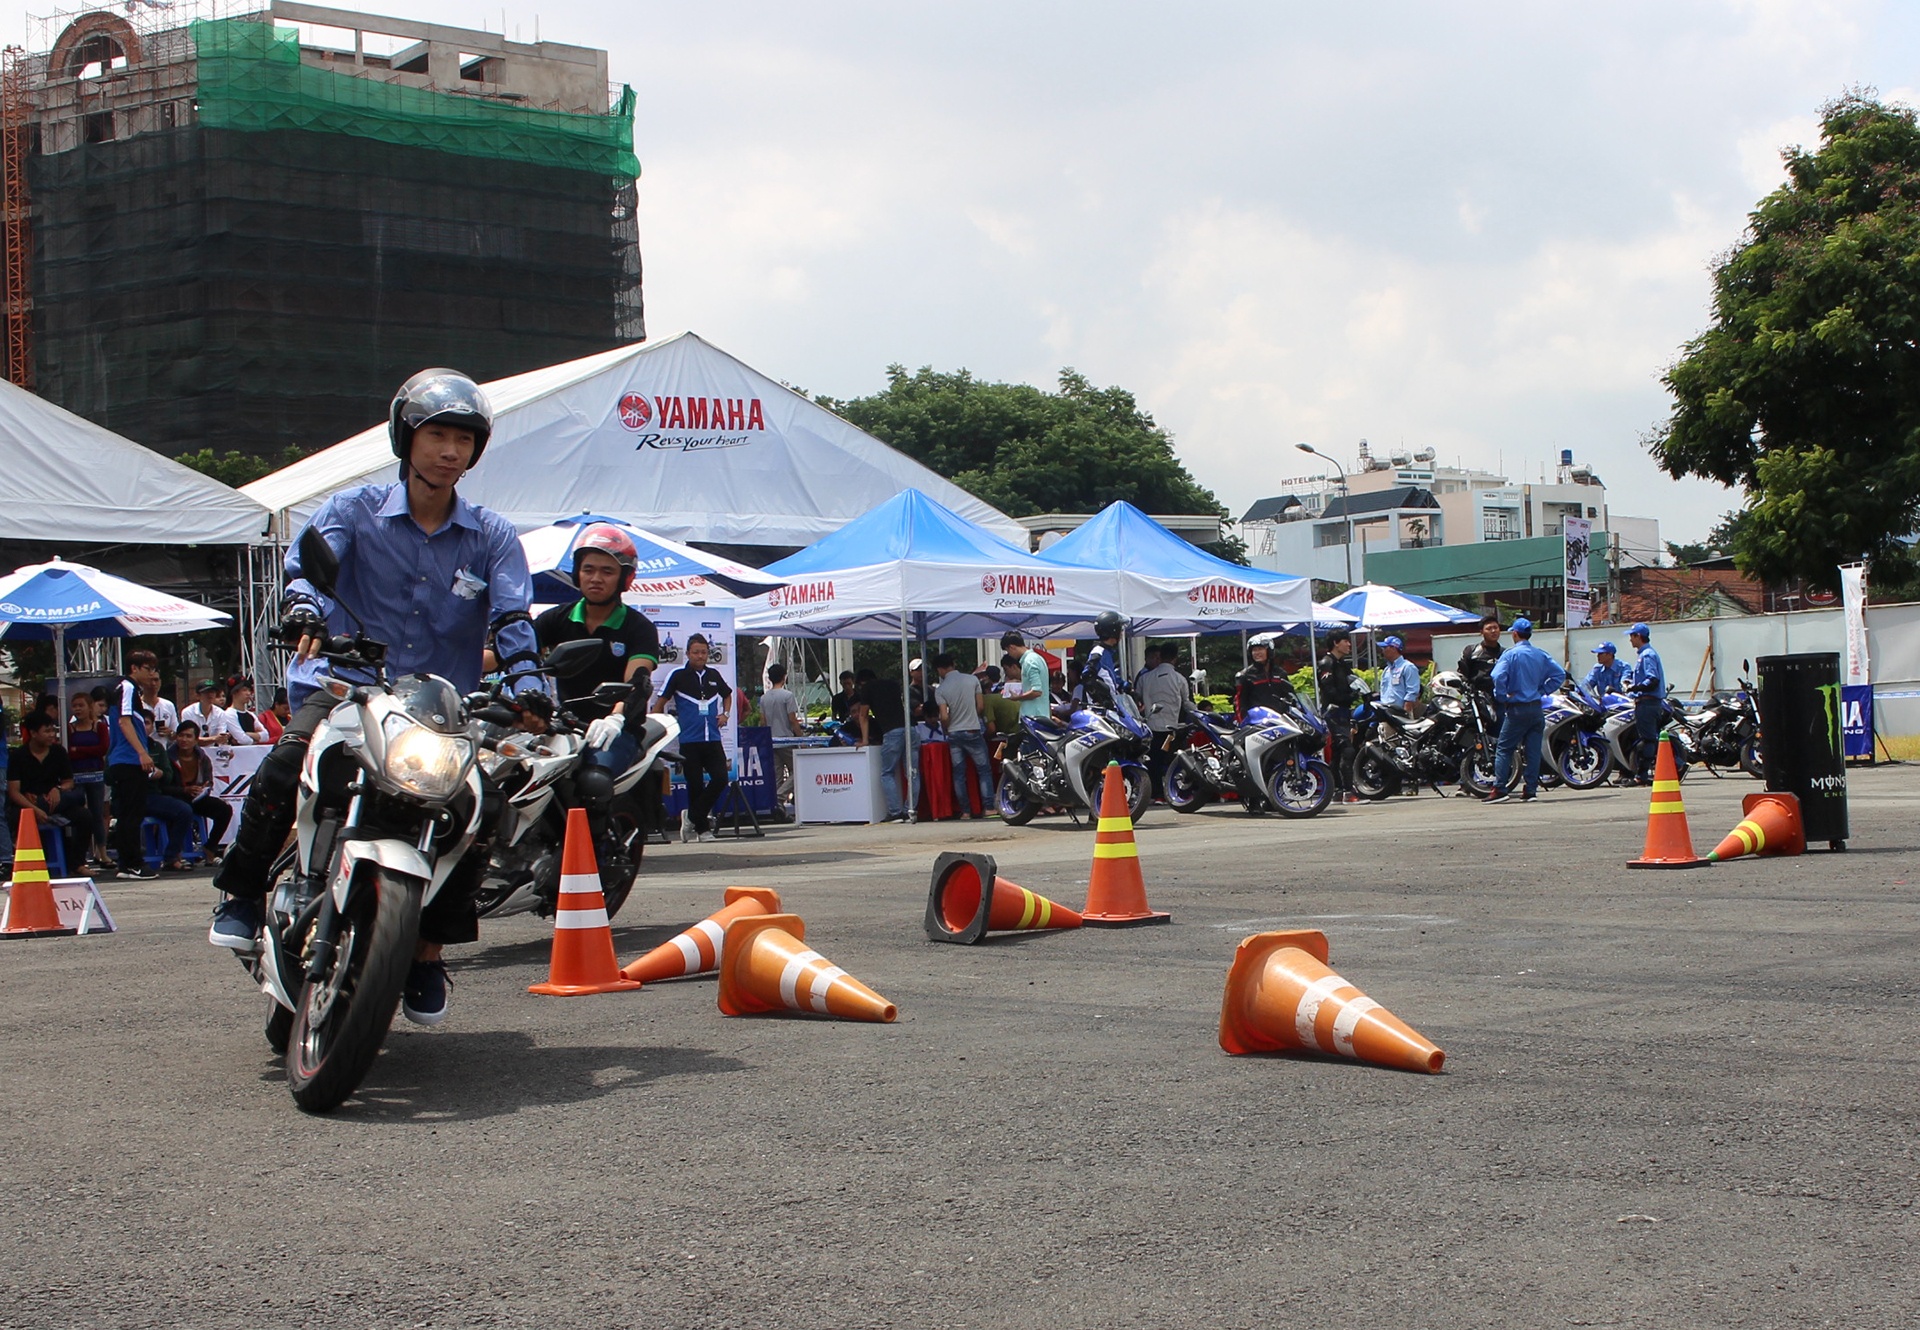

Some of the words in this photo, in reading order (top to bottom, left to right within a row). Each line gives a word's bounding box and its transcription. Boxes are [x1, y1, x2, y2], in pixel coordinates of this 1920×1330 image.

[654, 396, 765, 431] YAMAHA
[635, 433, 682, 451] Revs
[682, 436, 716, 452] Your
[715, 434, 750, 447] Heart
[1281, 476, 1309, 486] HOTEL
[637, 556, 679, 571] AHA
[782, 580, 835, 606] YAMAHA
[998, 574, 1056, 596] YAMAHA
[1202, 584, 1255, 604] YAMAHA
[23, 601, 102, 616] YAMAHA
[823, 773, 854, 785] YAMAHA
